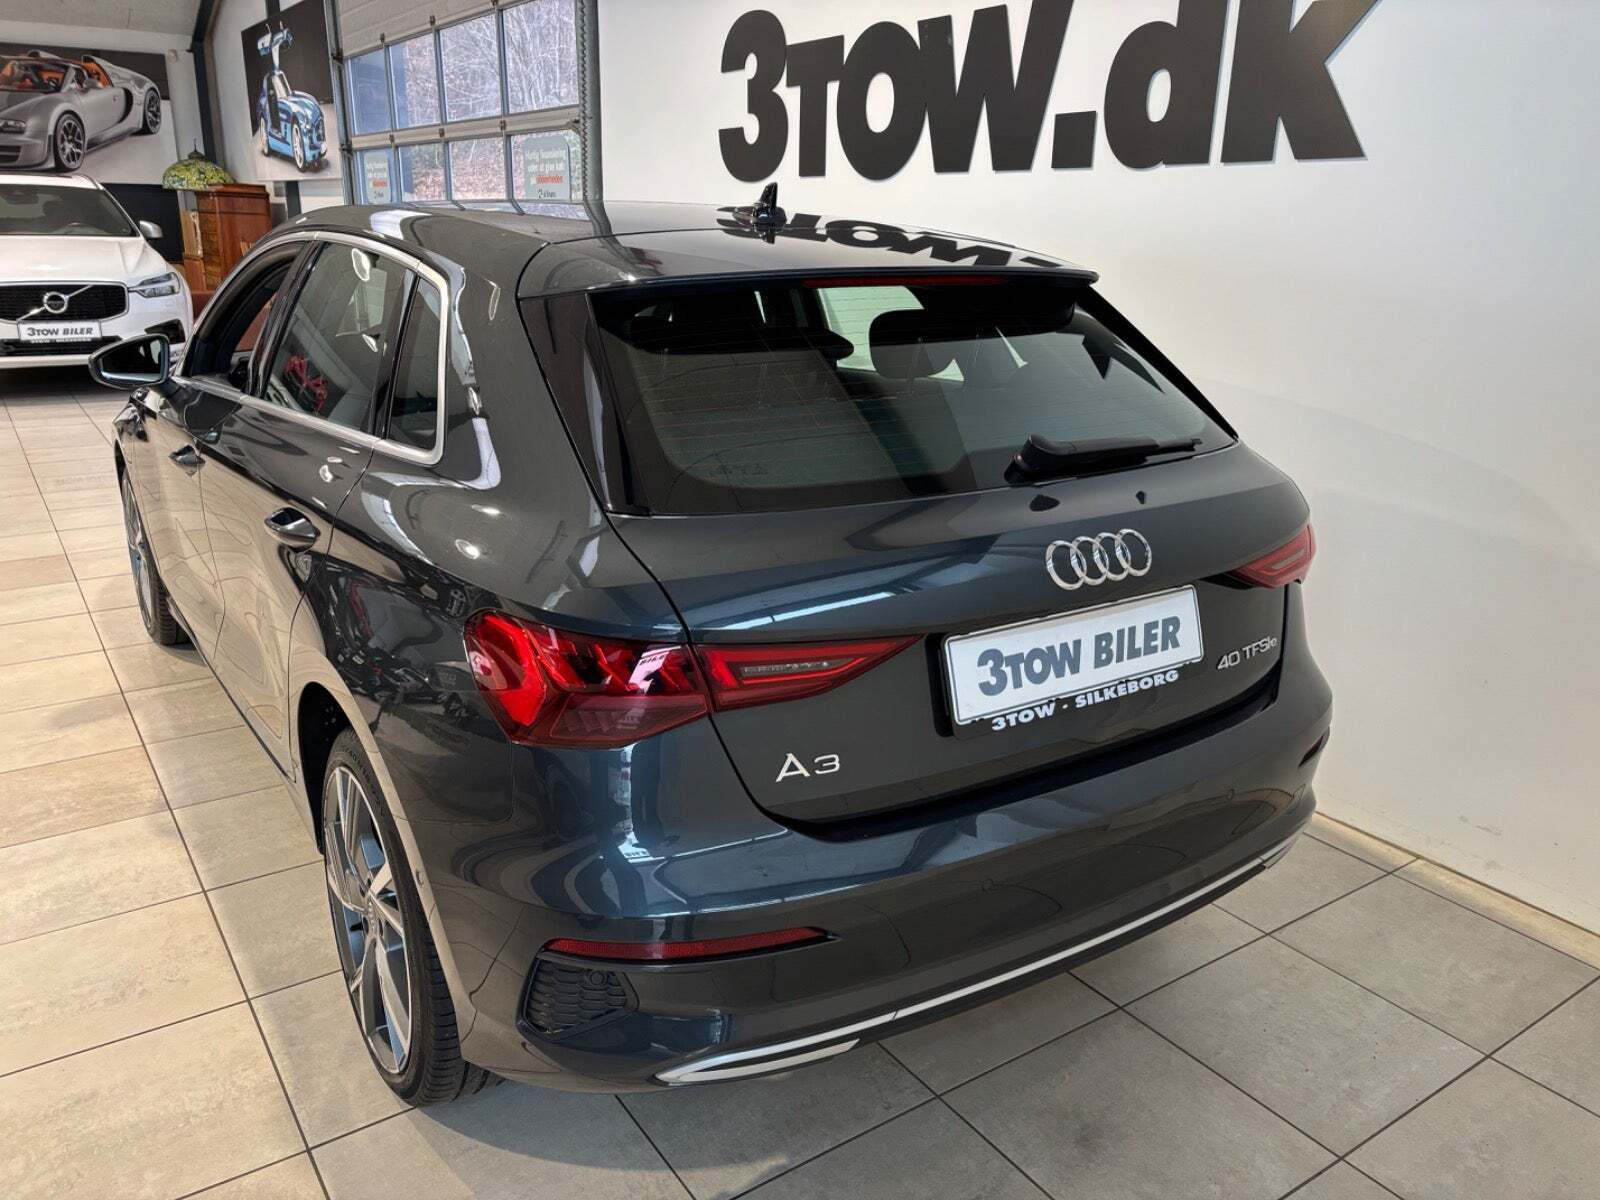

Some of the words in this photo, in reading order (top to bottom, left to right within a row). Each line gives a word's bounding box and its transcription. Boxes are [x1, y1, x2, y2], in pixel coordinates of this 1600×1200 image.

[27, 327, 59, 337] 3TOW
[63, 327, 93, 336] BILER
[977, 638, 1082, 697] 3TOW
[1094, 615, 1181, 669] BILER
[1217, 651, 1240, 670] 40
[991, 702, 1055, 731] 3TOW
[1075, 669, 1179, 708] SILKEBORG
[775, 752, 840, 782] A3
